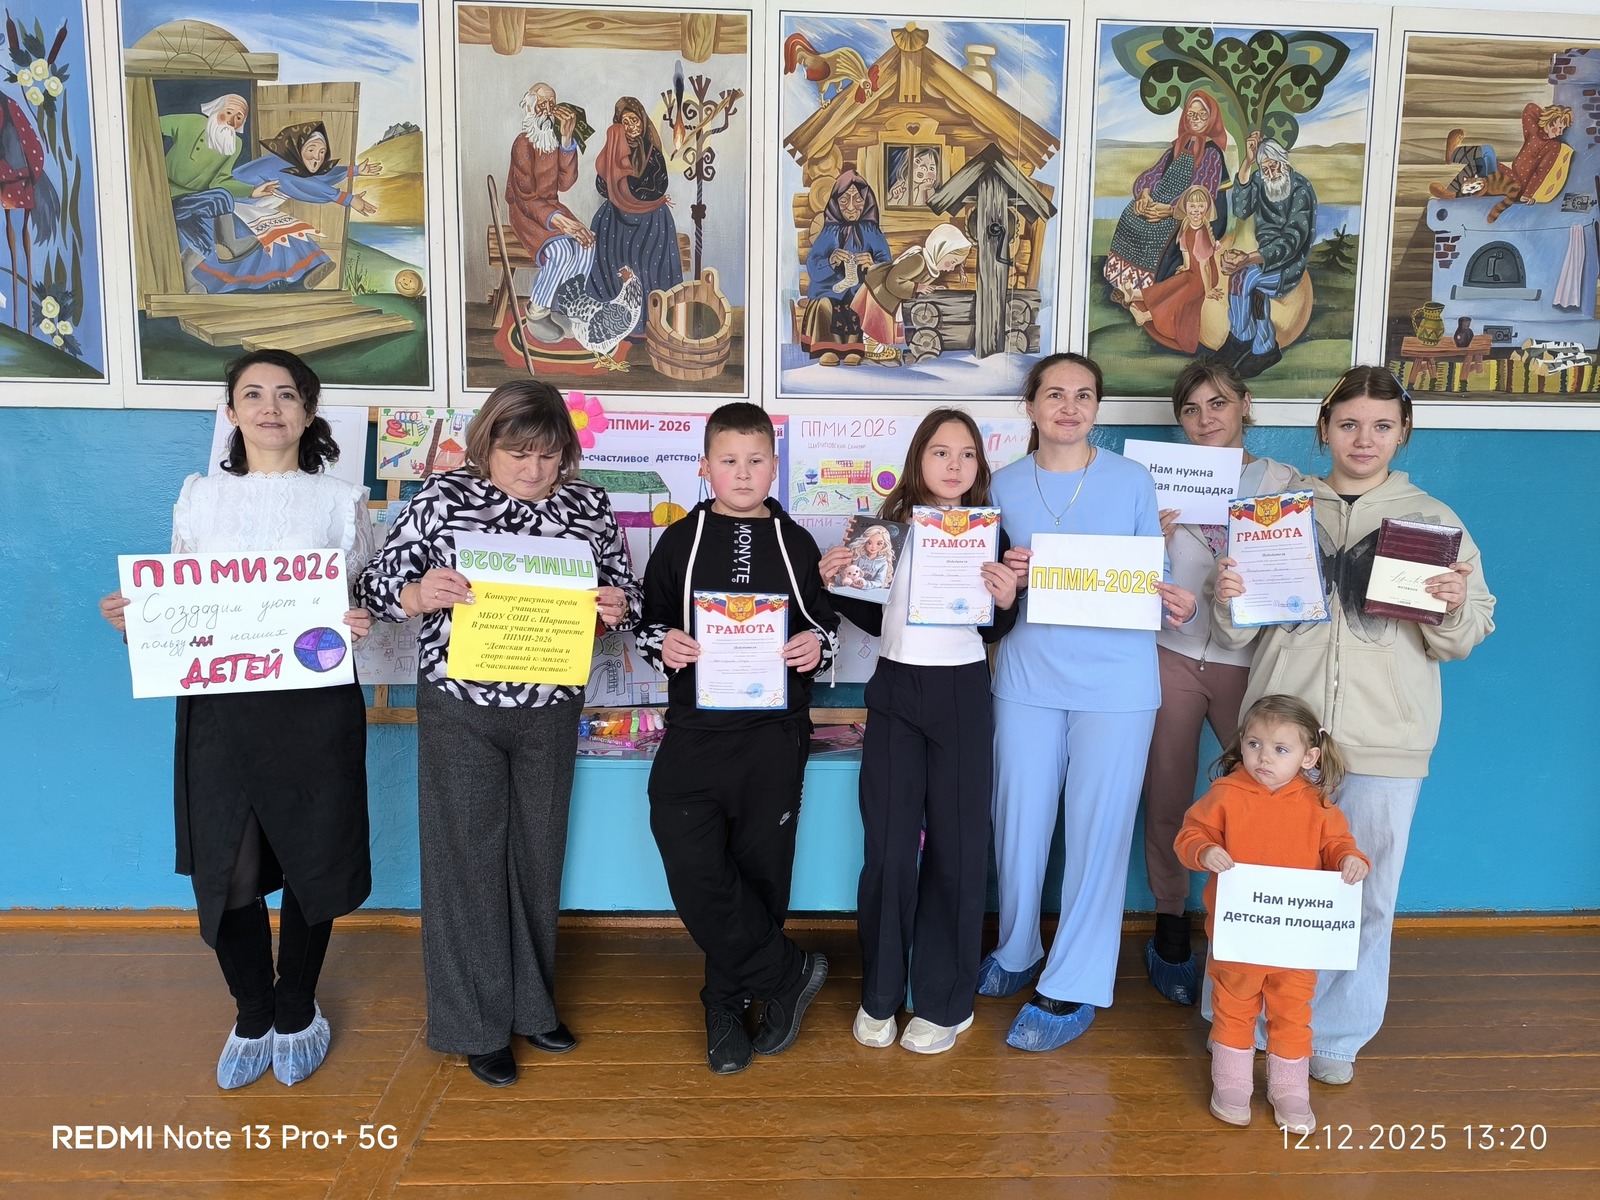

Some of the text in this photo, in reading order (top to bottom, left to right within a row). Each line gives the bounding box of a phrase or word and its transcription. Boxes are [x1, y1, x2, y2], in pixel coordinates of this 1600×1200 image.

[658, 420, 691, 432] 2026
[801, 420, 847, 438] ППМИ
[850, 418, 897, 438] 2026
[655, 453, 701, 463] детство!
[1149, 463, 1214, 478] Нам нужна
[1172, 484, 1234, 496] площадка
[797, 517, 833, 527] ППМИ
[1236, 527, 1303, 542] ГРАМОТА
[922, 538, 986, 548] ГРАМОТА
[736, 523, 752, 584] MONVTE
[273, 553, 339, 581] 2026
[458, 549, 594, 579] ППМИ-2026
[1031, 566, 1160, 594] ППМИ-2026
[484, 592, 578, 607] Конкурс рисунков среди
[142, 592, 243, 634] Создадим
[257, 598, 297, 622] уют
[510, 605, 550, 614] учащихся
[478, 611, 506, 620] МБОУ
[506, 613, 530, 622] СОШ
[539, 616, 581, 626] Шарипово
[509, 625, 544, 633] участия
[551, 628, 585, 636] проекте
[706, 623, 775, 635] ГРАМОТА
[141, 637, 187, 657] пользу
[229, 627, 289, 642] наших
[502, 633, 553, 643] ППМИ-2026
[524, 645, 564, 654] площадка
[179, 647, 284, 690] ДЕТЕЙ
[1252, 891, 1334, 909] Нам нужна
[1223, 910, 1356, 932] детская площадка
